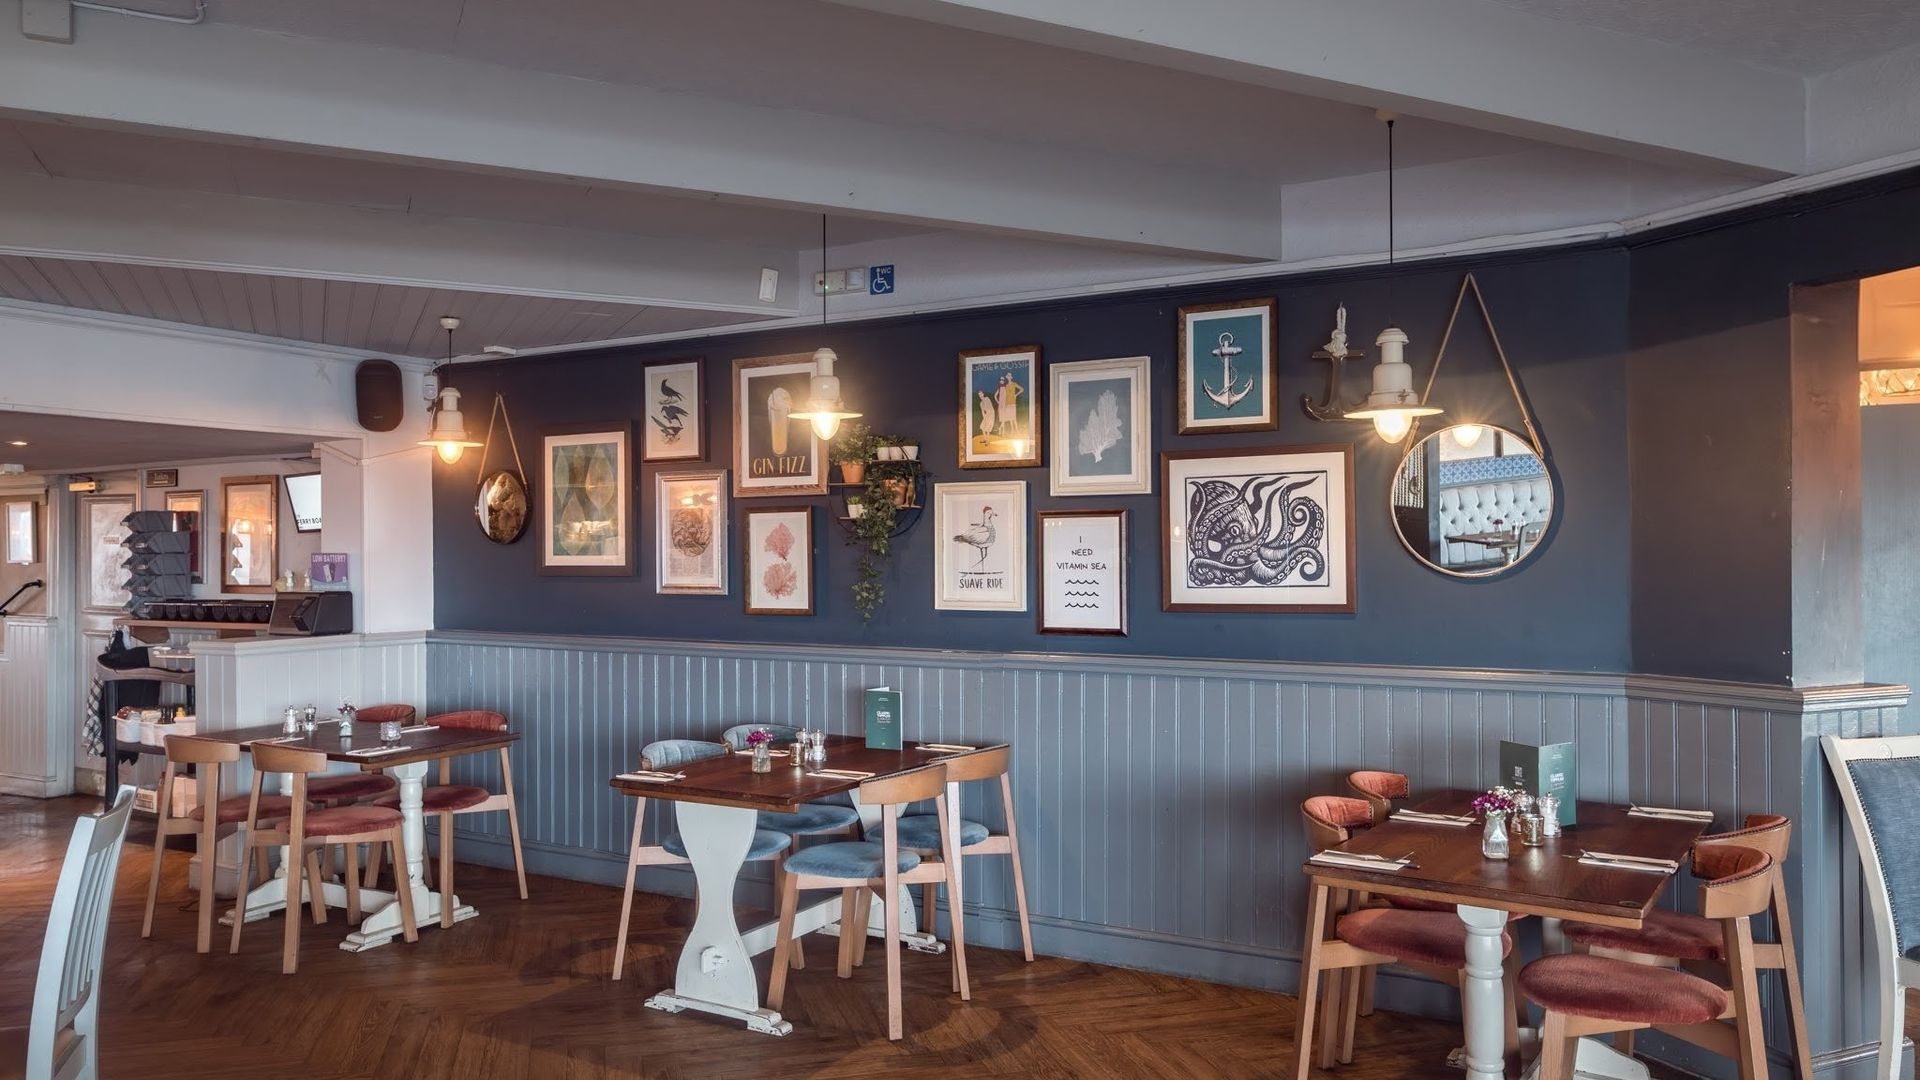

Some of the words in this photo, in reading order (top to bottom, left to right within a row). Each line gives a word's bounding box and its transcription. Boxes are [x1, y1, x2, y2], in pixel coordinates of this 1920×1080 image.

[880, 267, 892, 275] WC
[753, 457, 774, 475] GIN
[779, 455, 806, 474] FIZZ
[1071, 548, 1093, 556] NEED
[312, 554, 323, 563] LOW
[1056, 562, 1088, 570] VITAMIN
[1090, 562, 1107, 570] SEA
[958, 578, 983, 589] SUAVE
[986, 578, 1003, 589] RIDE
